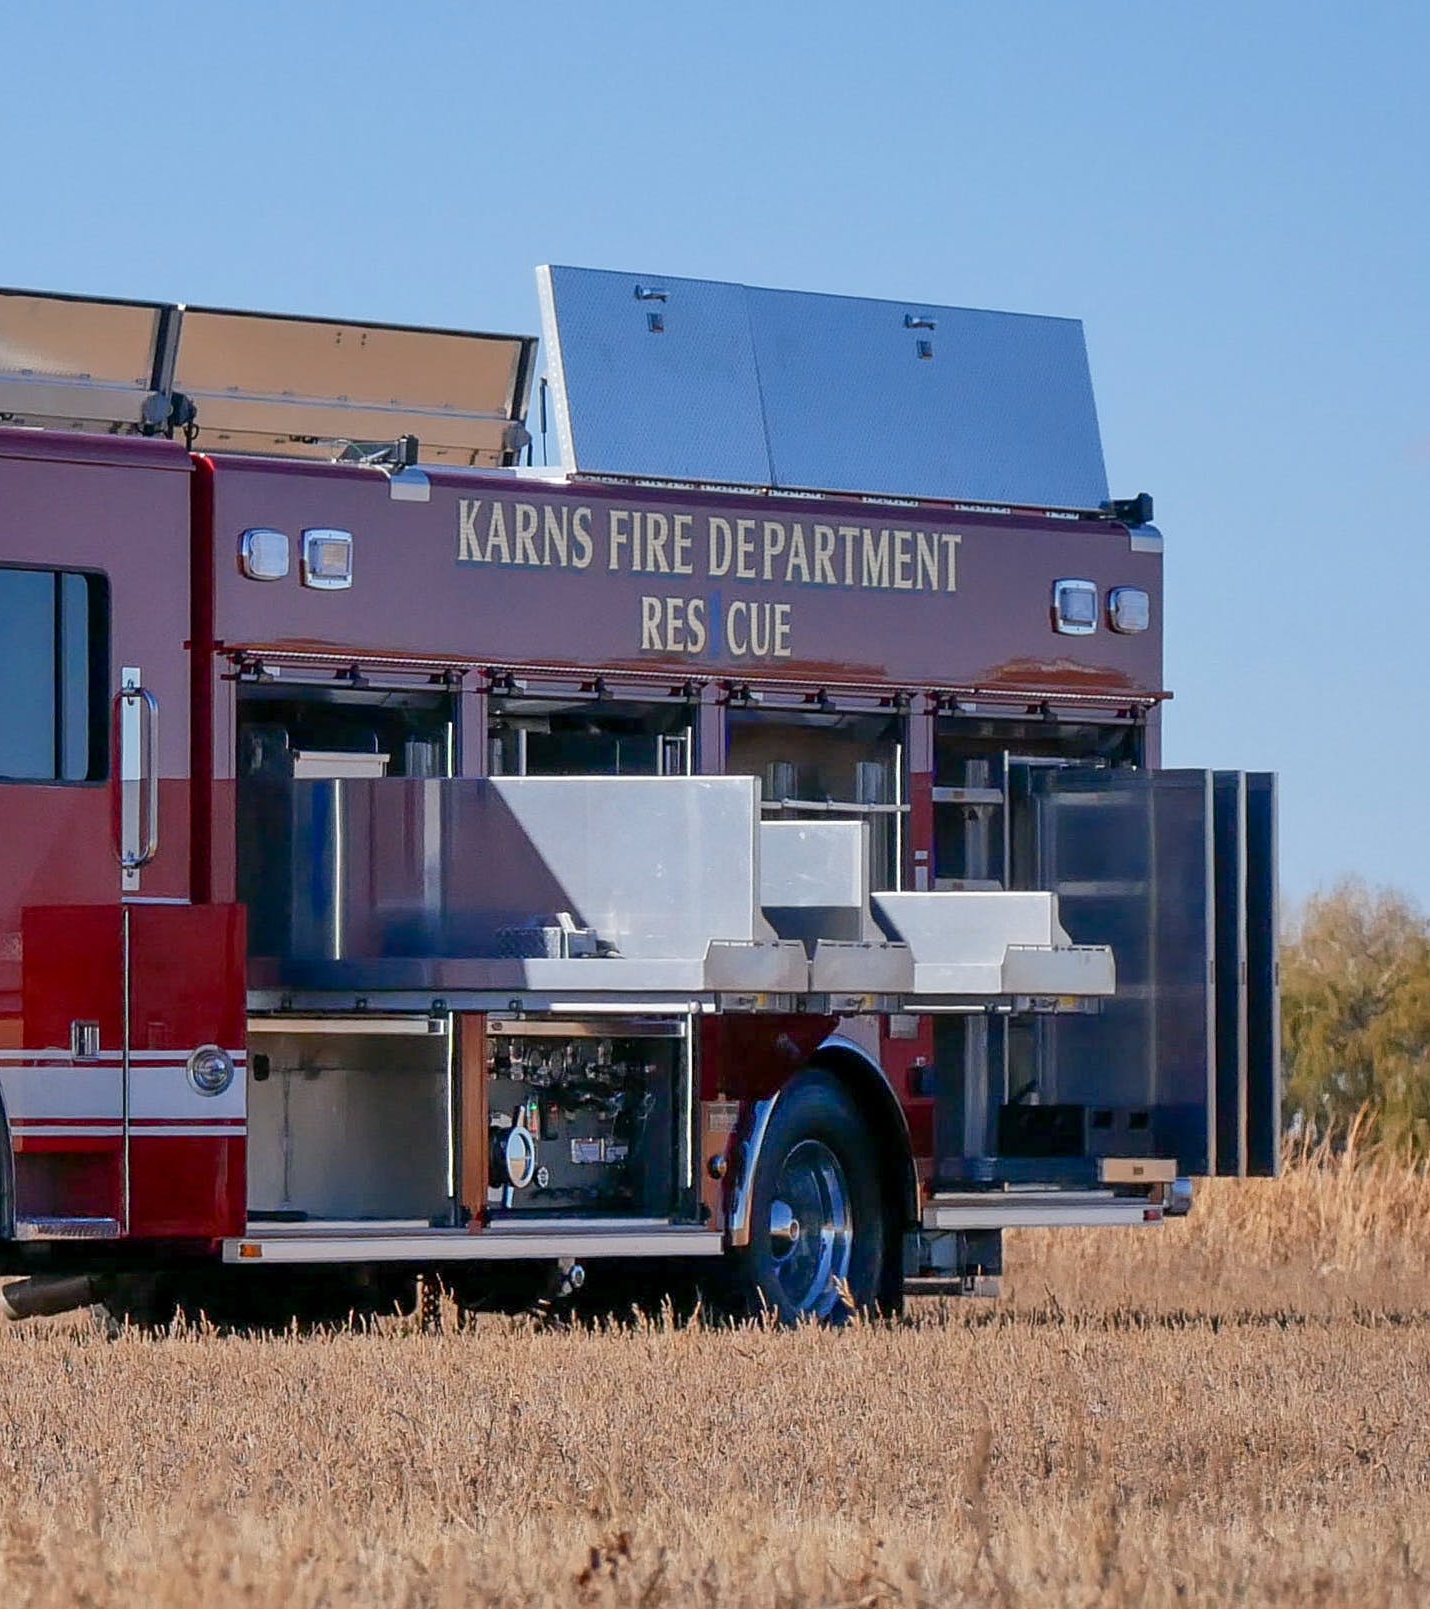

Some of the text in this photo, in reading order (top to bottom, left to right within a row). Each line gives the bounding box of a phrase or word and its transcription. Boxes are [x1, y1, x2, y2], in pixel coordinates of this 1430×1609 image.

[457, 499, 962, 592] KARNS FIRE DEPARTMENT
